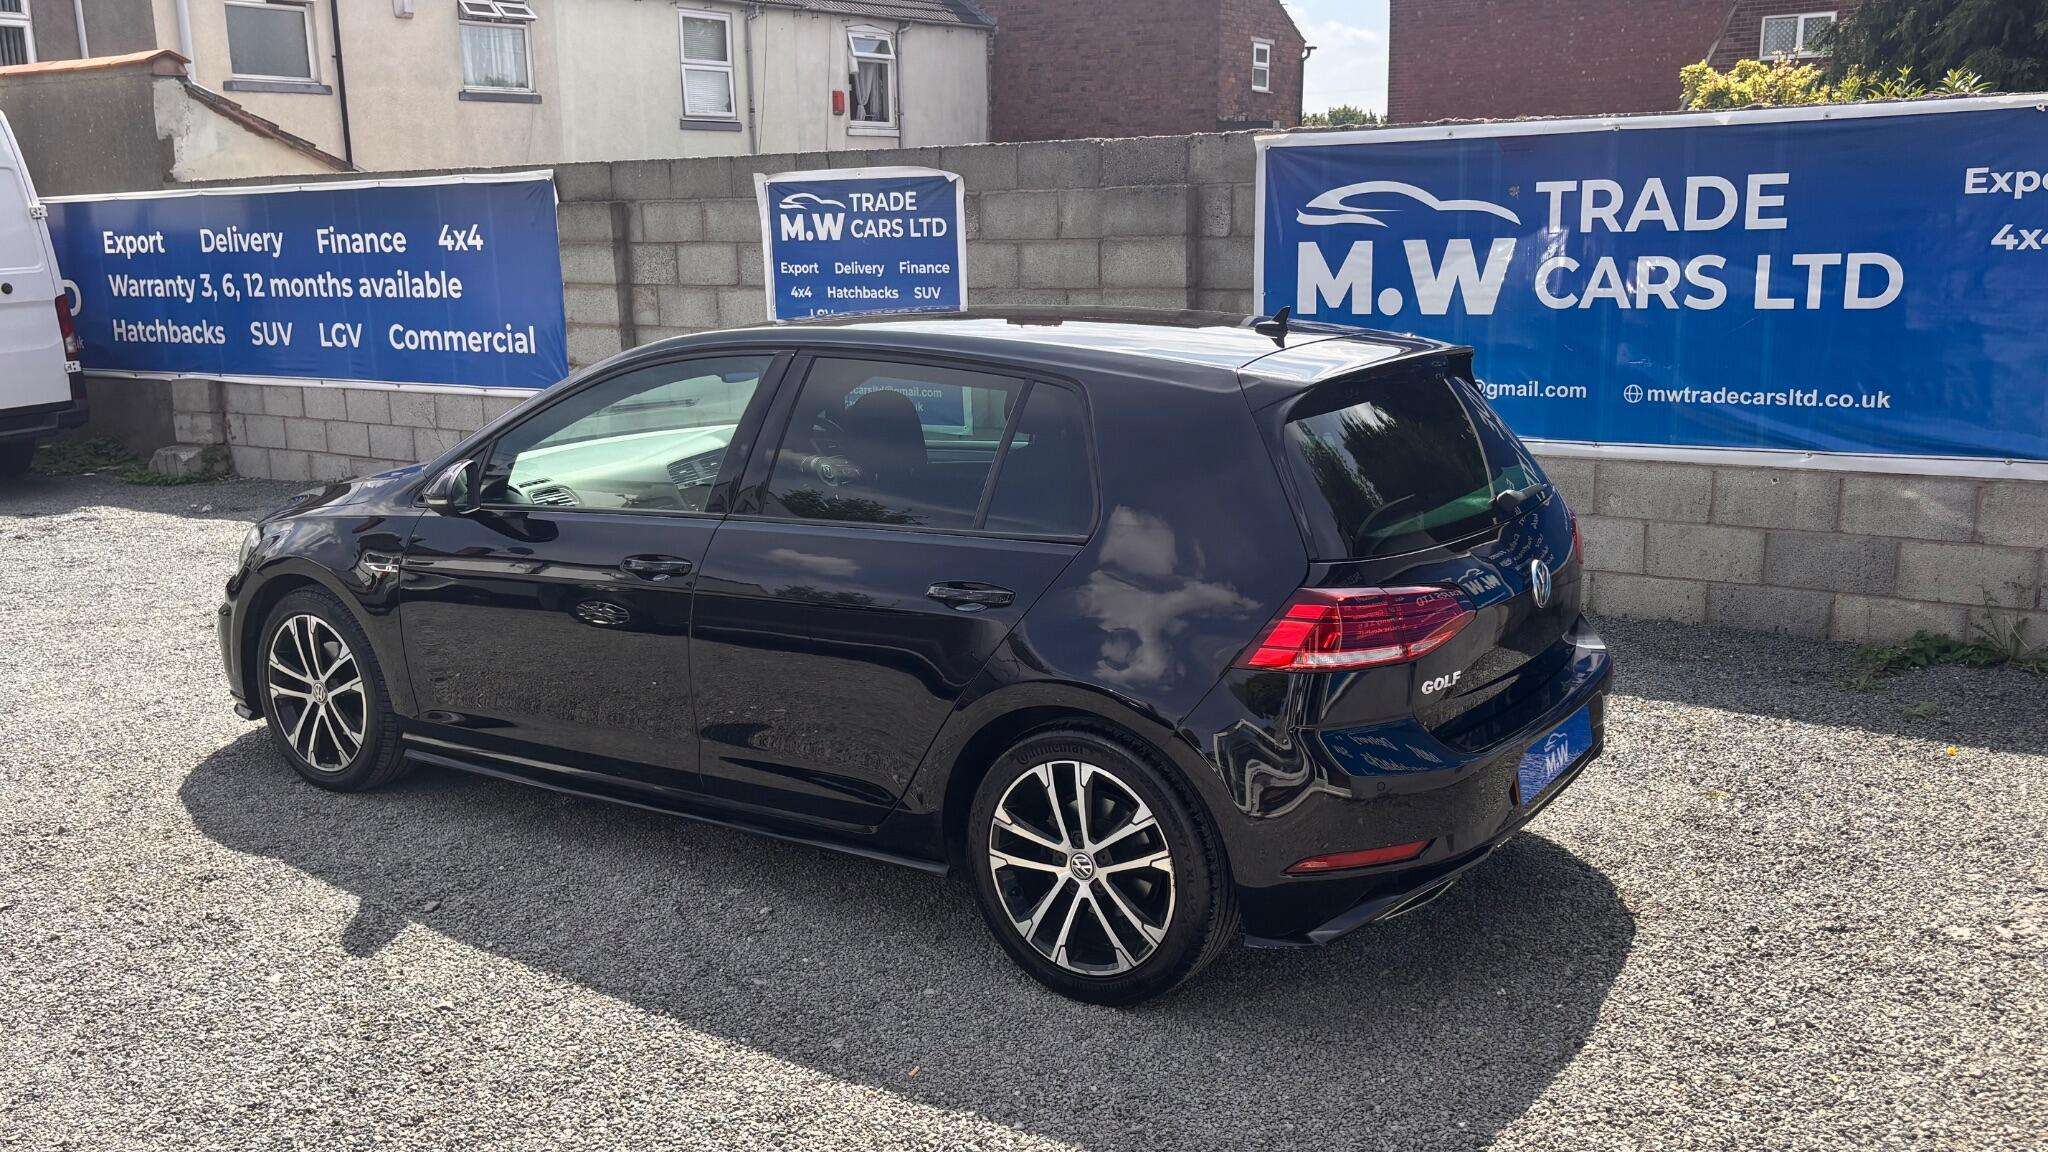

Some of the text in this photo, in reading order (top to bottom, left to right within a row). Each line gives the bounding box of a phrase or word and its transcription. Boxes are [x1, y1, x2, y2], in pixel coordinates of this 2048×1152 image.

[1964, 166, 2048, 200] Exp
[848, 190, 918, 213] TRADE
[1536, 172, 1790, 236] TRADE
[102, 223, 484, 260] Export Delivery Finance 4x4
[781, 212, 846, 242] M.W
[850, 217, 948, 238] CARS LTD
[1990, 223, 2048, 251] 4x
[780, 260, 951, 278] Export Delivery Finance
[1296, 237, 1518, 316] M.W
[1534, 252, 1904, 311] CARS LTD
[108, 273, 196, 304] Warranty
[199, 273, 218, 302] 3,
[222, 273, 241, 302] 6,
[244, 272, 266, 298] 12
[269, 272, 354, 298] months
[358, 269, 463, 300] available
[790, 285, 942, 300] 4x4 Hatchbacks SUV
[112, 318, 226, 345] Hatchbacks
[250, 321, 293, 347] SUV
[318, 322, 363, 349] LGV
[388, 322, 536, 355] Commercial
[1646, 384, 1892, 411] mwtradecarsltd.co.uk
[1420, 670, 1464, 696] GOLF
